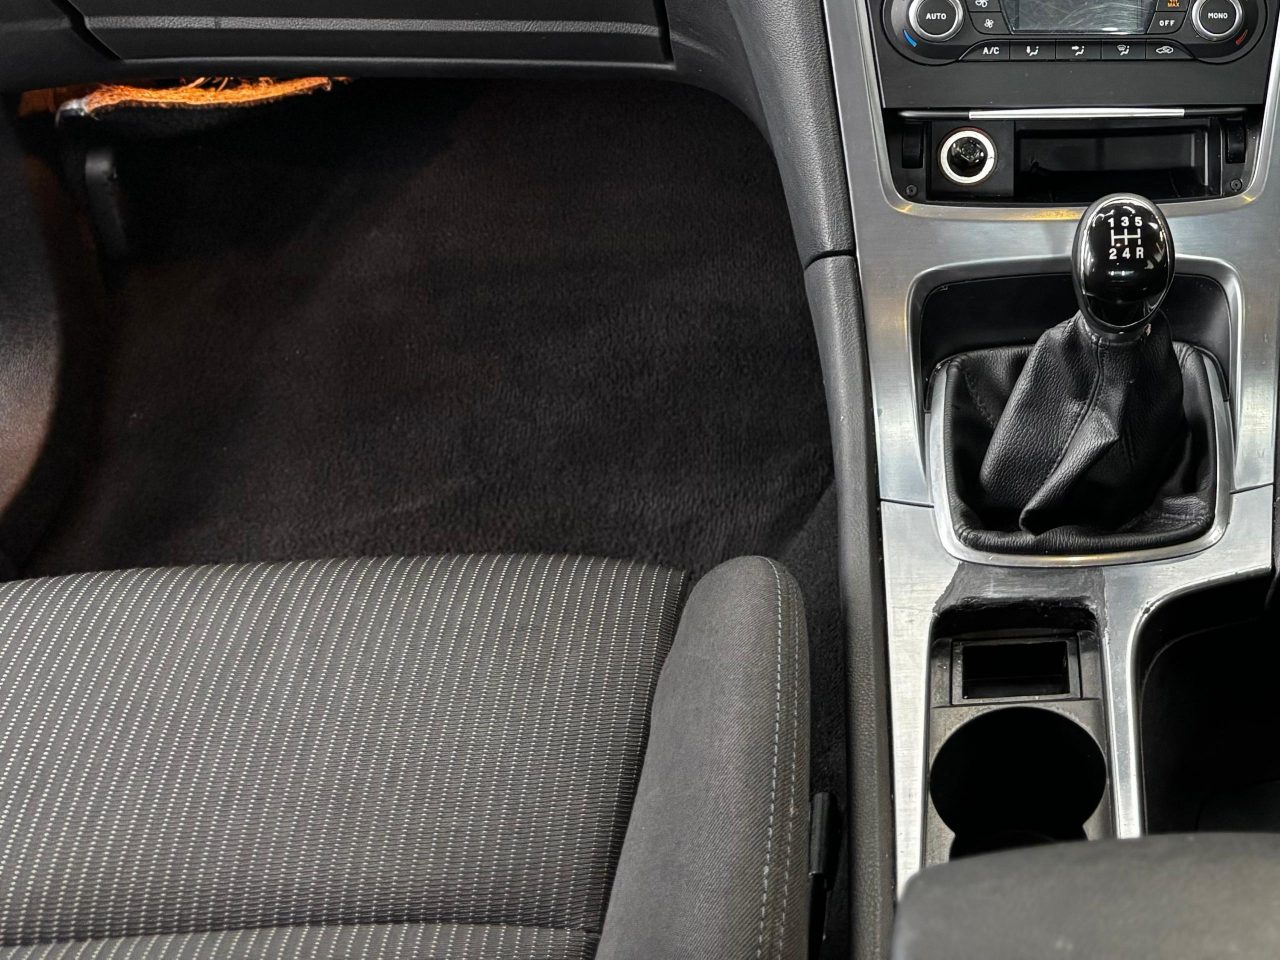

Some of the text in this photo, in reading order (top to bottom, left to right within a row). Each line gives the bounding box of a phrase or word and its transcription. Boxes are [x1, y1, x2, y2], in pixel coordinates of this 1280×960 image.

[982, 46, 999, 55] A/C
[1108, 216, 1143, 228] 1 3 5
[1109, 247, 1144, 260] 2 4 R
